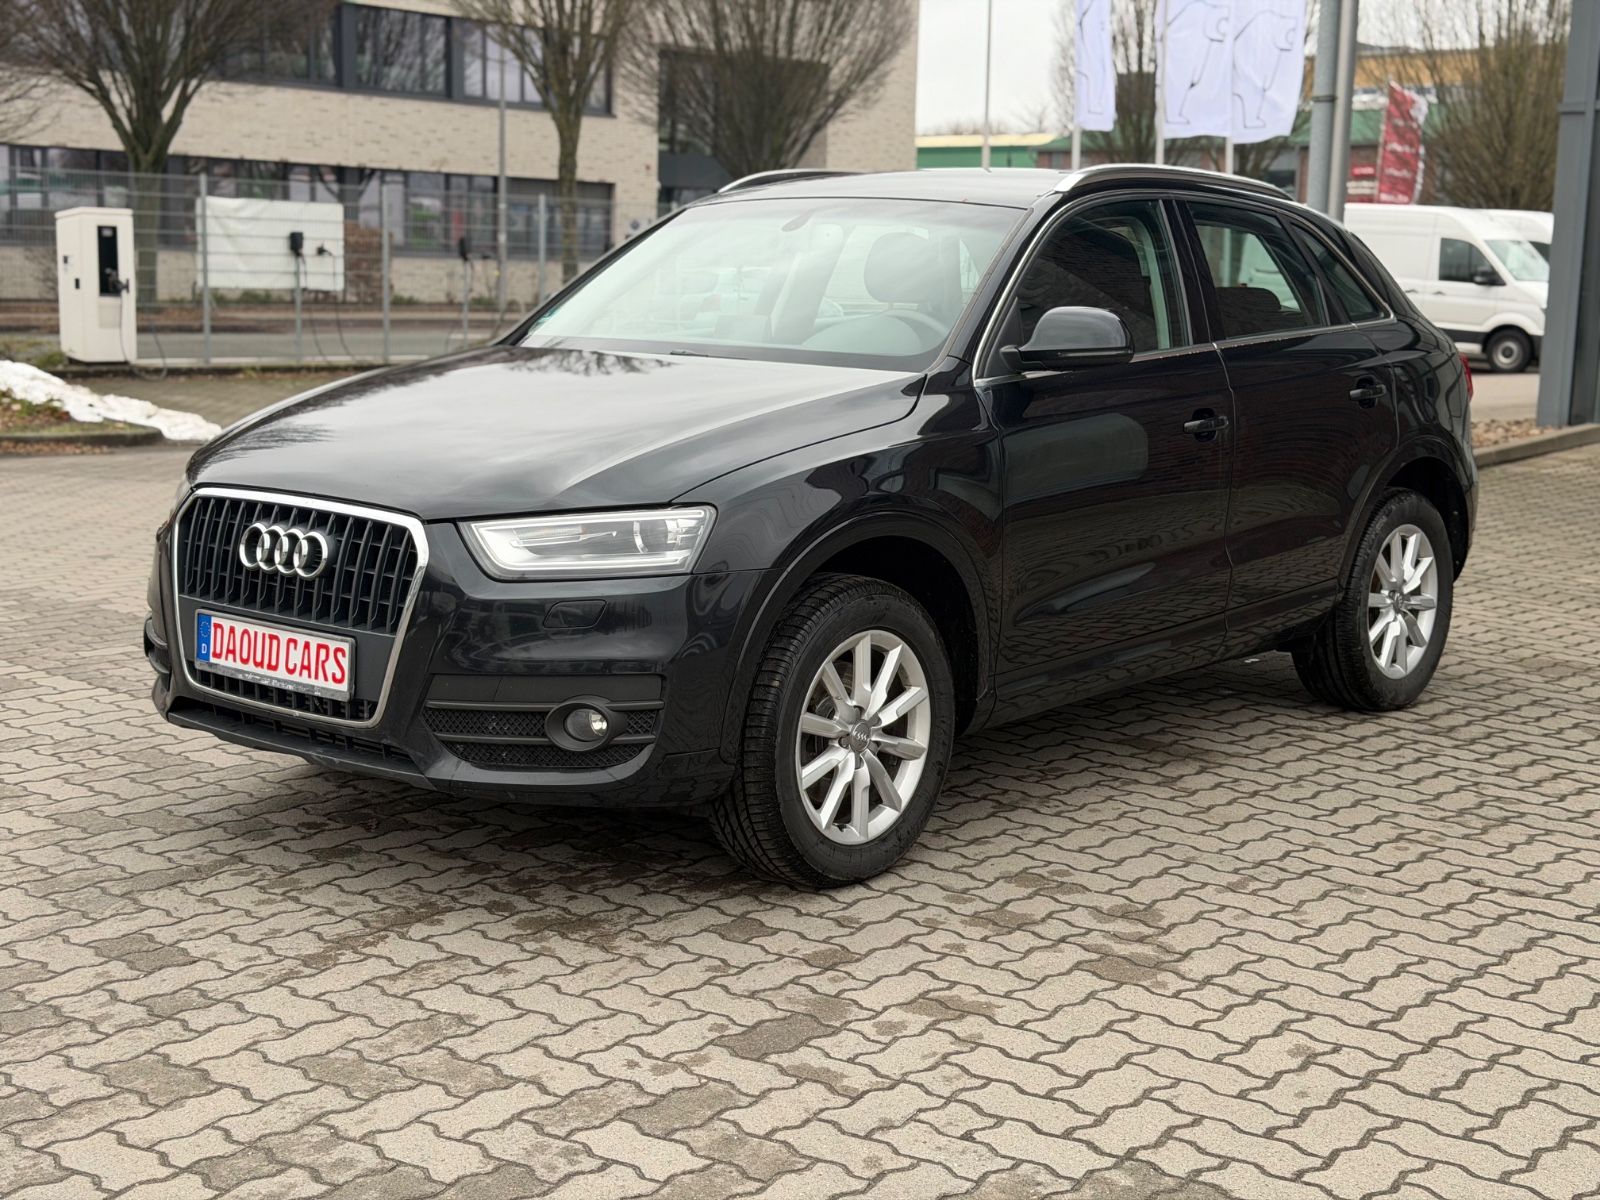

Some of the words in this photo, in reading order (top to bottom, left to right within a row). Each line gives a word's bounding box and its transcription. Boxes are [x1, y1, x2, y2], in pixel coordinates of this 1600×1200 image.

[201, 643, 208, 654] D
[211, 622, 281, 672] DAOUD
[284, 637, 347, 685] CARS
